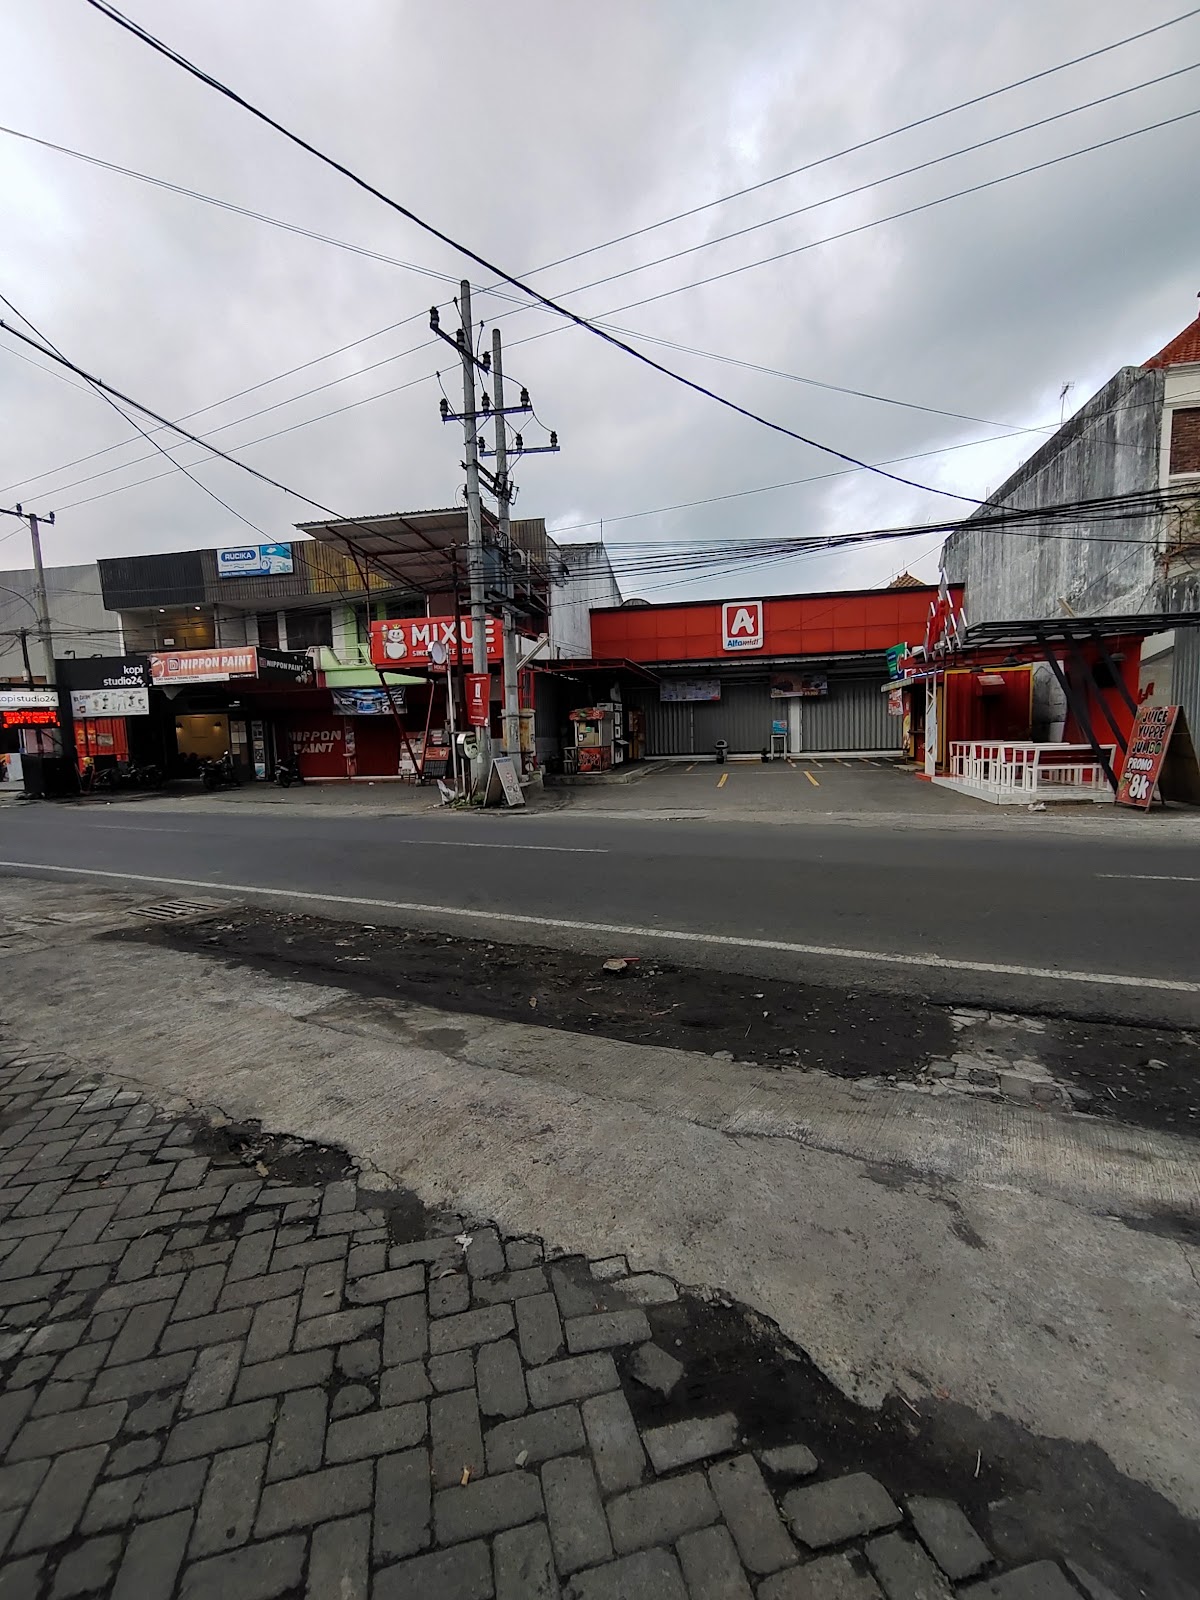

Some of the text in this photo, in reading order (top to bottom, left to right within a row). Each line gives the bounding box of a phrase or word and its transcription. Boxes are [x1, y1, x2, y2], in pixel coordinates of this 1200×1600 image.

[225, 552, 252, 561] RUCIKA
[731, 608, 755, 635] A
[727, 638, 759, 647] Alfamidi
[412, 650, 429, 658] SINCE
[180, 654, 252, 670] NIPPON PAINT
[266, 660, 304, 673] NIPPON PAINT
[123, 664, 144, 677] kopi
[103, 676, 143, 686] studio24
[1143, 710, 1168, 724] JUICE
[1137, 724, 1167, 740] YUPPE
[293, 743, 335, 754] PAINT
[1131, 740, 1163, 756] JUMBO
[1127, 757, 1154, 771] PROMO
